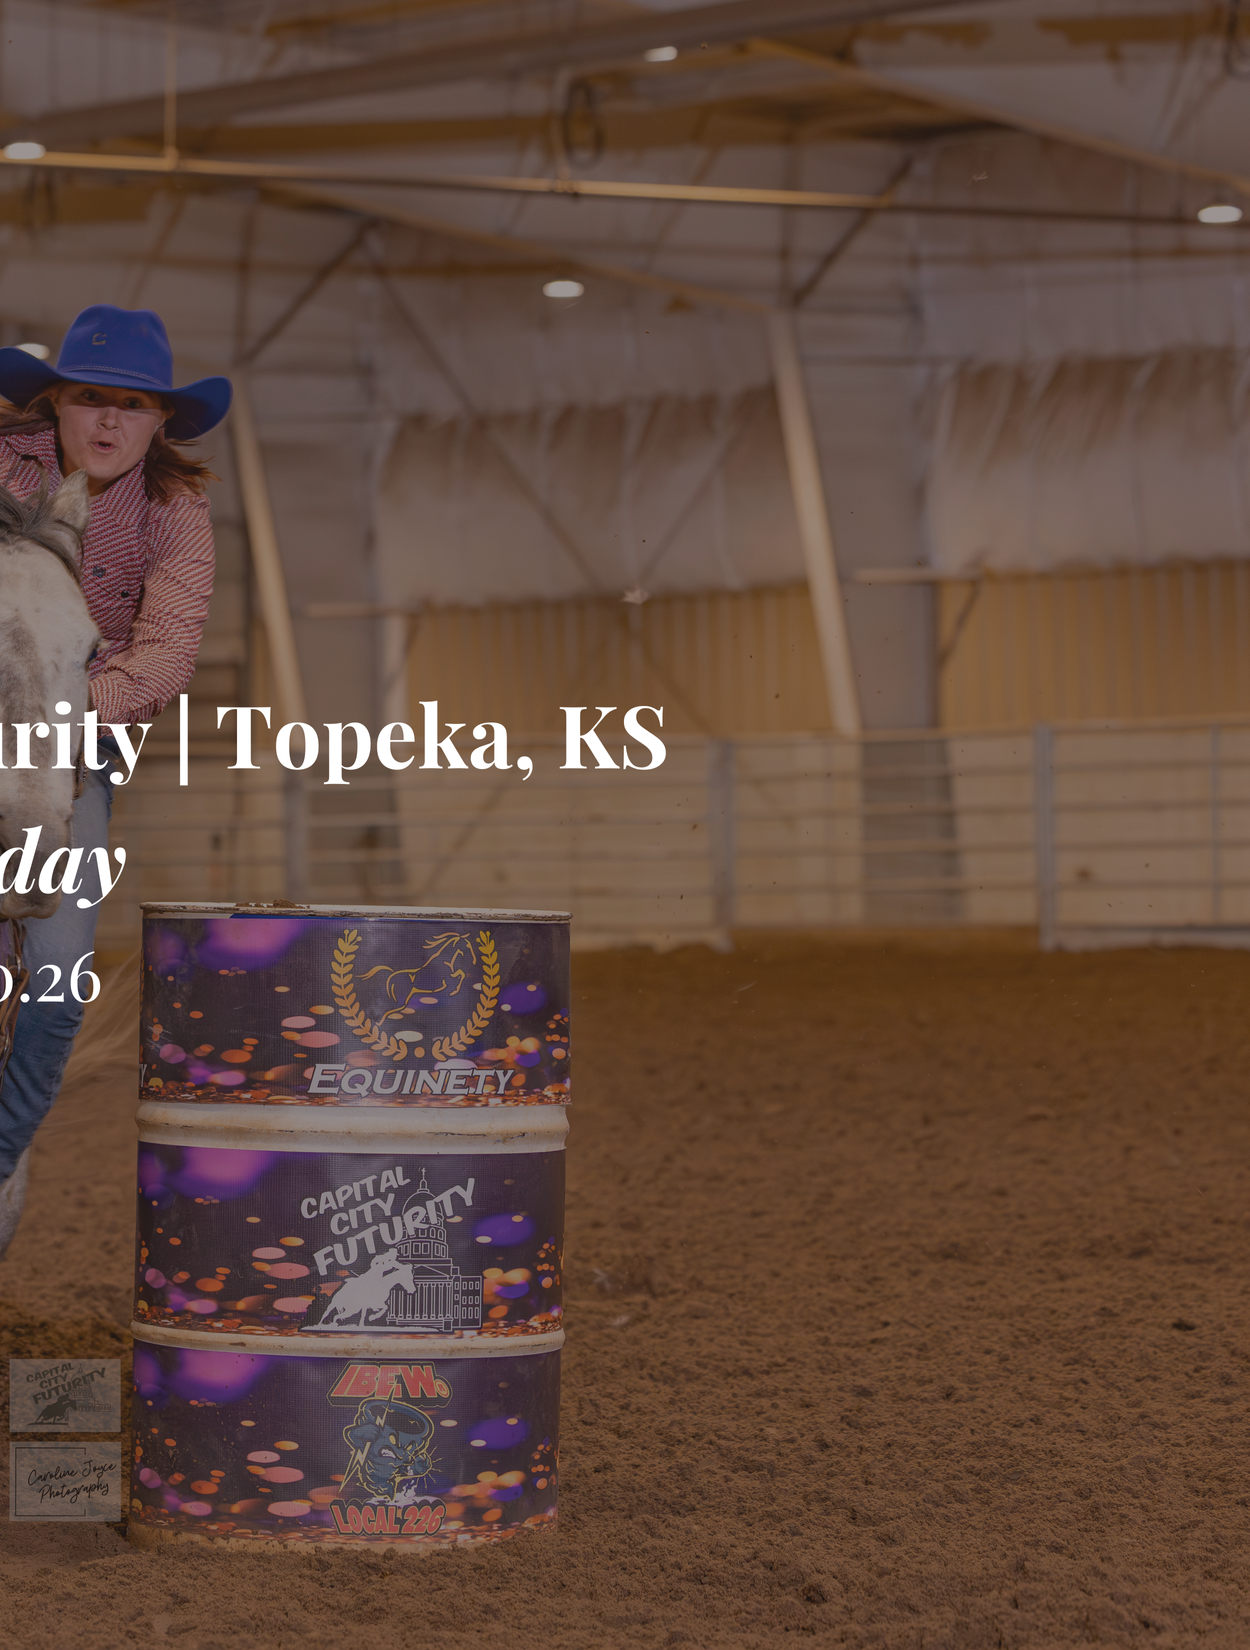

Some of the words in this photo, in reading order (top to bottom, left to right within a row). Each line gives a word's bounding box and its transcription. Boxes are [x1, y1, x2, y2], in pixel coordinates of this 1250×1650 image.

[307, 1062, 515, 1098] EQUINETY
[300, 1166, 411, 1219] CAPITAL
[313, 1178, 475, 1277] FUTURITY
[330, 1193, 395, 1235] CITY
[330, 1505, 400, 1535] LOCAL
[400, 1505, 446, 1535] 226
